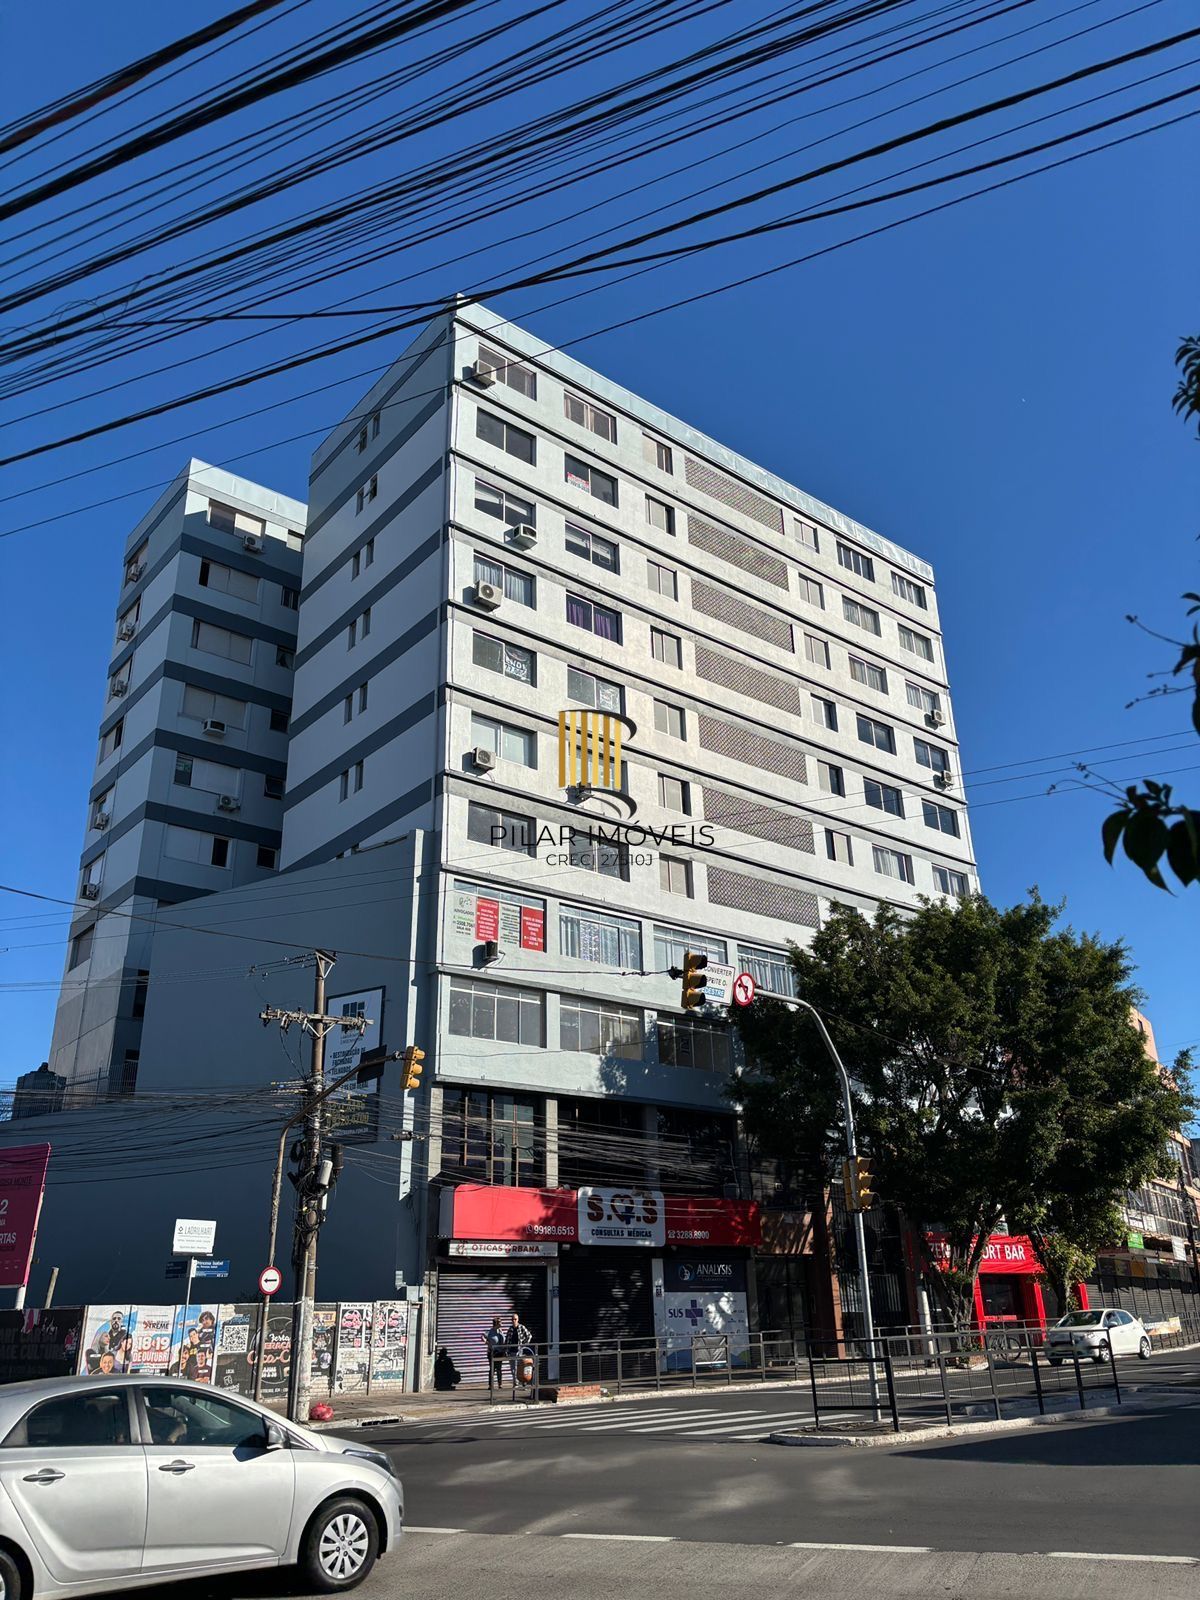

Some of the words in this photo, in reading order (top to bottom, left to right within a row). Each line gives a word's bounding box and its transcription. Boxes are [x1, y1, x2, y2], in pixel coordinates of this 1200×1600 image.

[534, 1225, 576, 1237] 99189.6513
[591, 1228, 625, 1239] CONSULTAS
[627, 1228, 652, 1239] MÉDICAS
[1004, 1244, 1026, 1261] BAR
[697, 1264, 733, 1277] ANALYSIS
[668, 1308, 684, 1319] SUS
[142, 1351, 168, 1363] OUTUBR
